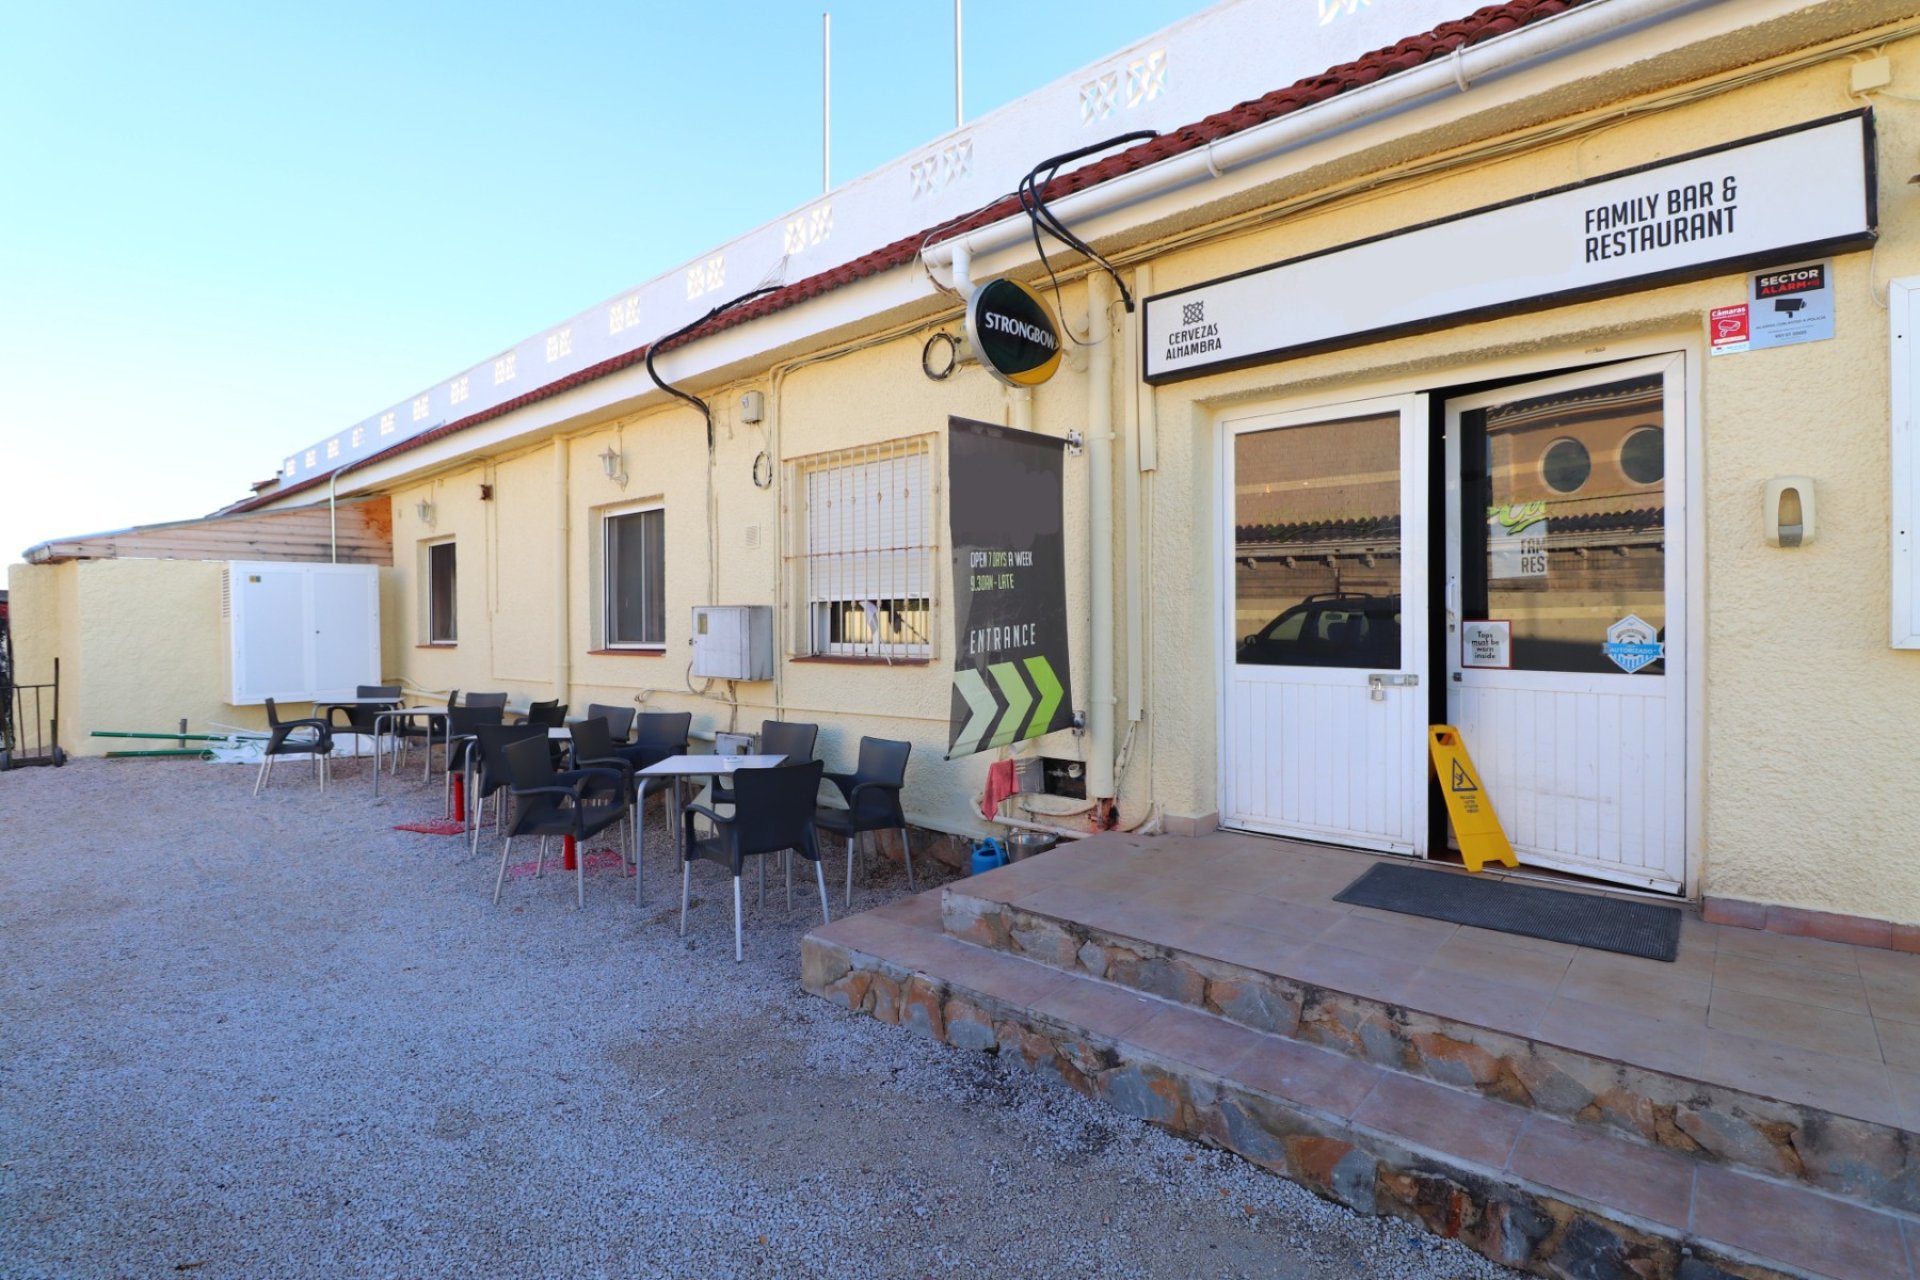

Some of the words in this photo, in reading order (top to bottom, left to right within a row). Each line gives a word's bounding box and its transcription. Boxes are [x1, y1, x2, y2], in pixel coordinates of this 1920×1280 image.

[1586, 194, 1659, 234] FAMILY
[1667, 181, 1713, 215] BAR
[1723, 176, 1737, 202] &
[1586, 206, 1737, 263] RESTAURANT
[1761, 269, 1818, 287] SECTOR
[1761, 281, 1807, 294] ALARM
[985, 312, 1056, 350] STRONGBOW
[1169, 323, 1218, 345] CERVEZAS
[1166, 337, 1222, 360] ALHAMBRA
[970, 552, 987, 568] OPEN
[988, 552, 992, 567] 7
[992, 552, 1007, 567] DAYS
[1008, 551, 1014, 567] A
[1014, 551, 1033, 566] WEEK
[1521, 556, 1544, 573] RES
[998, 574, 1014, 590] LATE
[970, 623, 1036, 654] ENTRANCE
